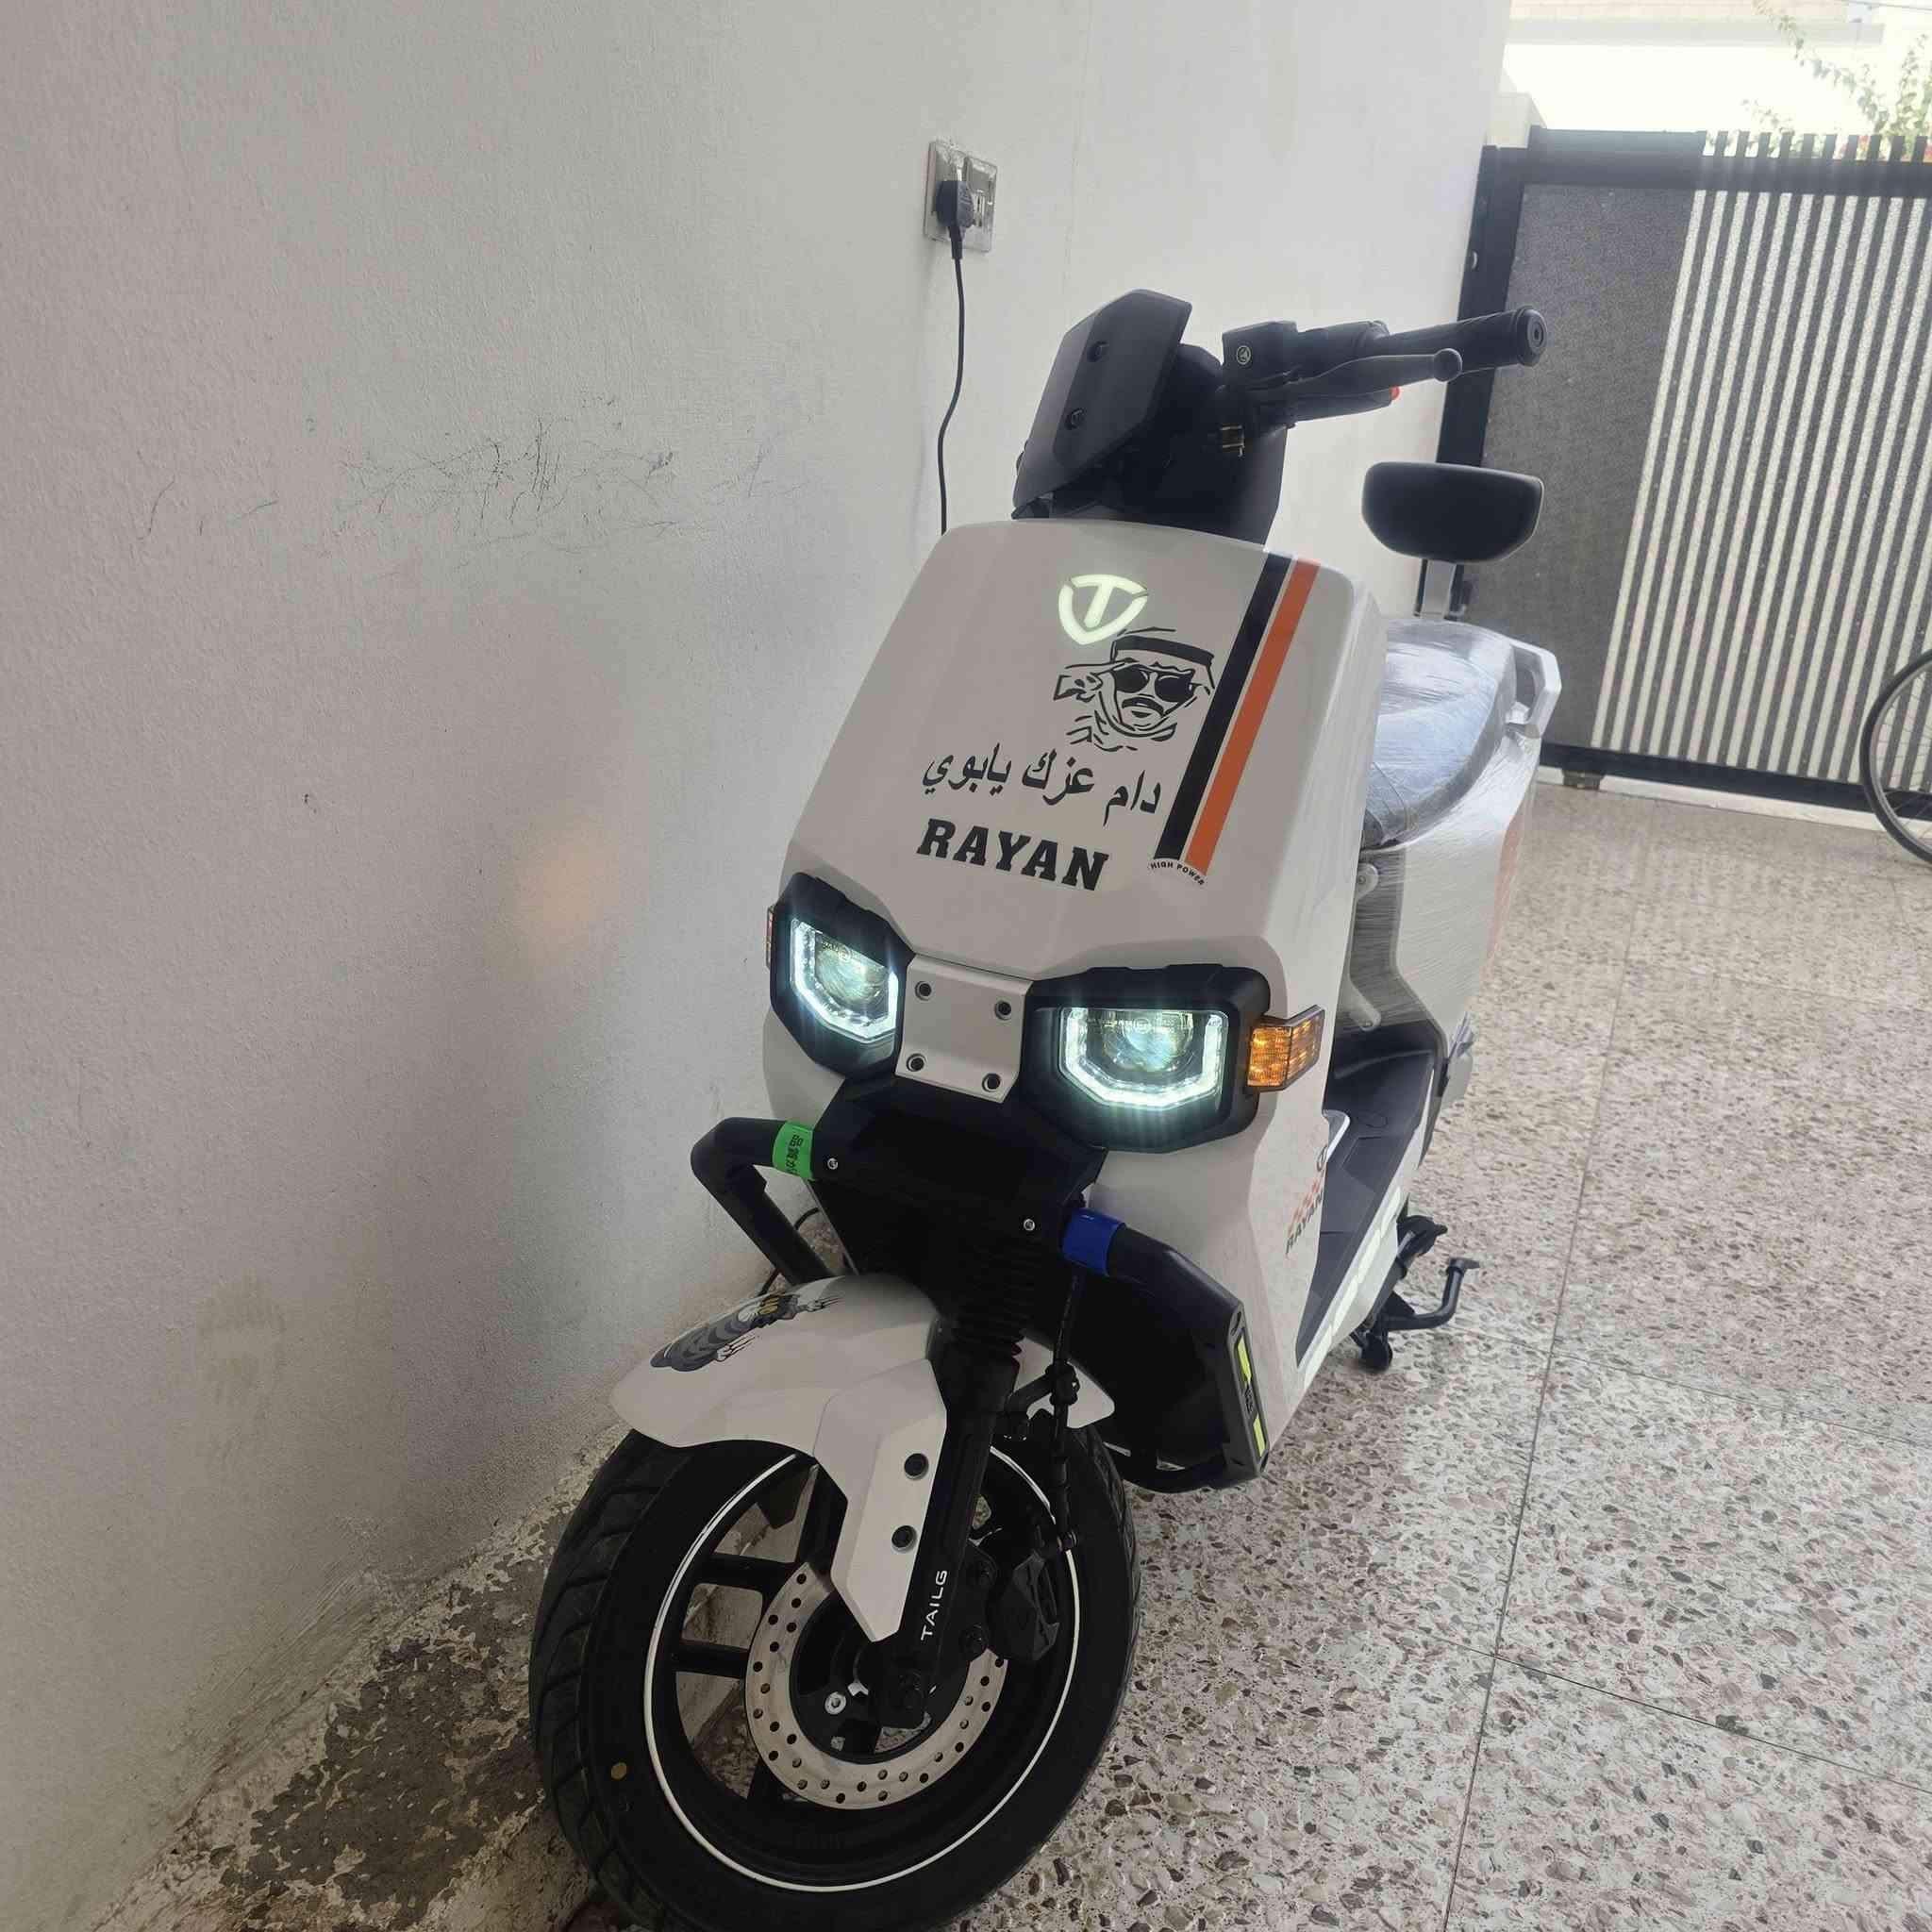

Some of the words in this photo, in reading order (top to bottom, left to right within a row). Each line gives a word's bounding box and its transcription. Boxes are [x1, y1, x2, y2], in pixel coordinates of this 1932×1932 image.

[922, 741, 1012, 797] يابوي
[1021, 748, 1095, 807] عزك
[1102, 769, 1161, 827] دام
[916, 817, 1110, 891] RAYAN
[1150, 861, 1174, 870] HIGH
[1176, 863, 1206, 886] POWER
[920, 1570, 948, 1641] TAILG
